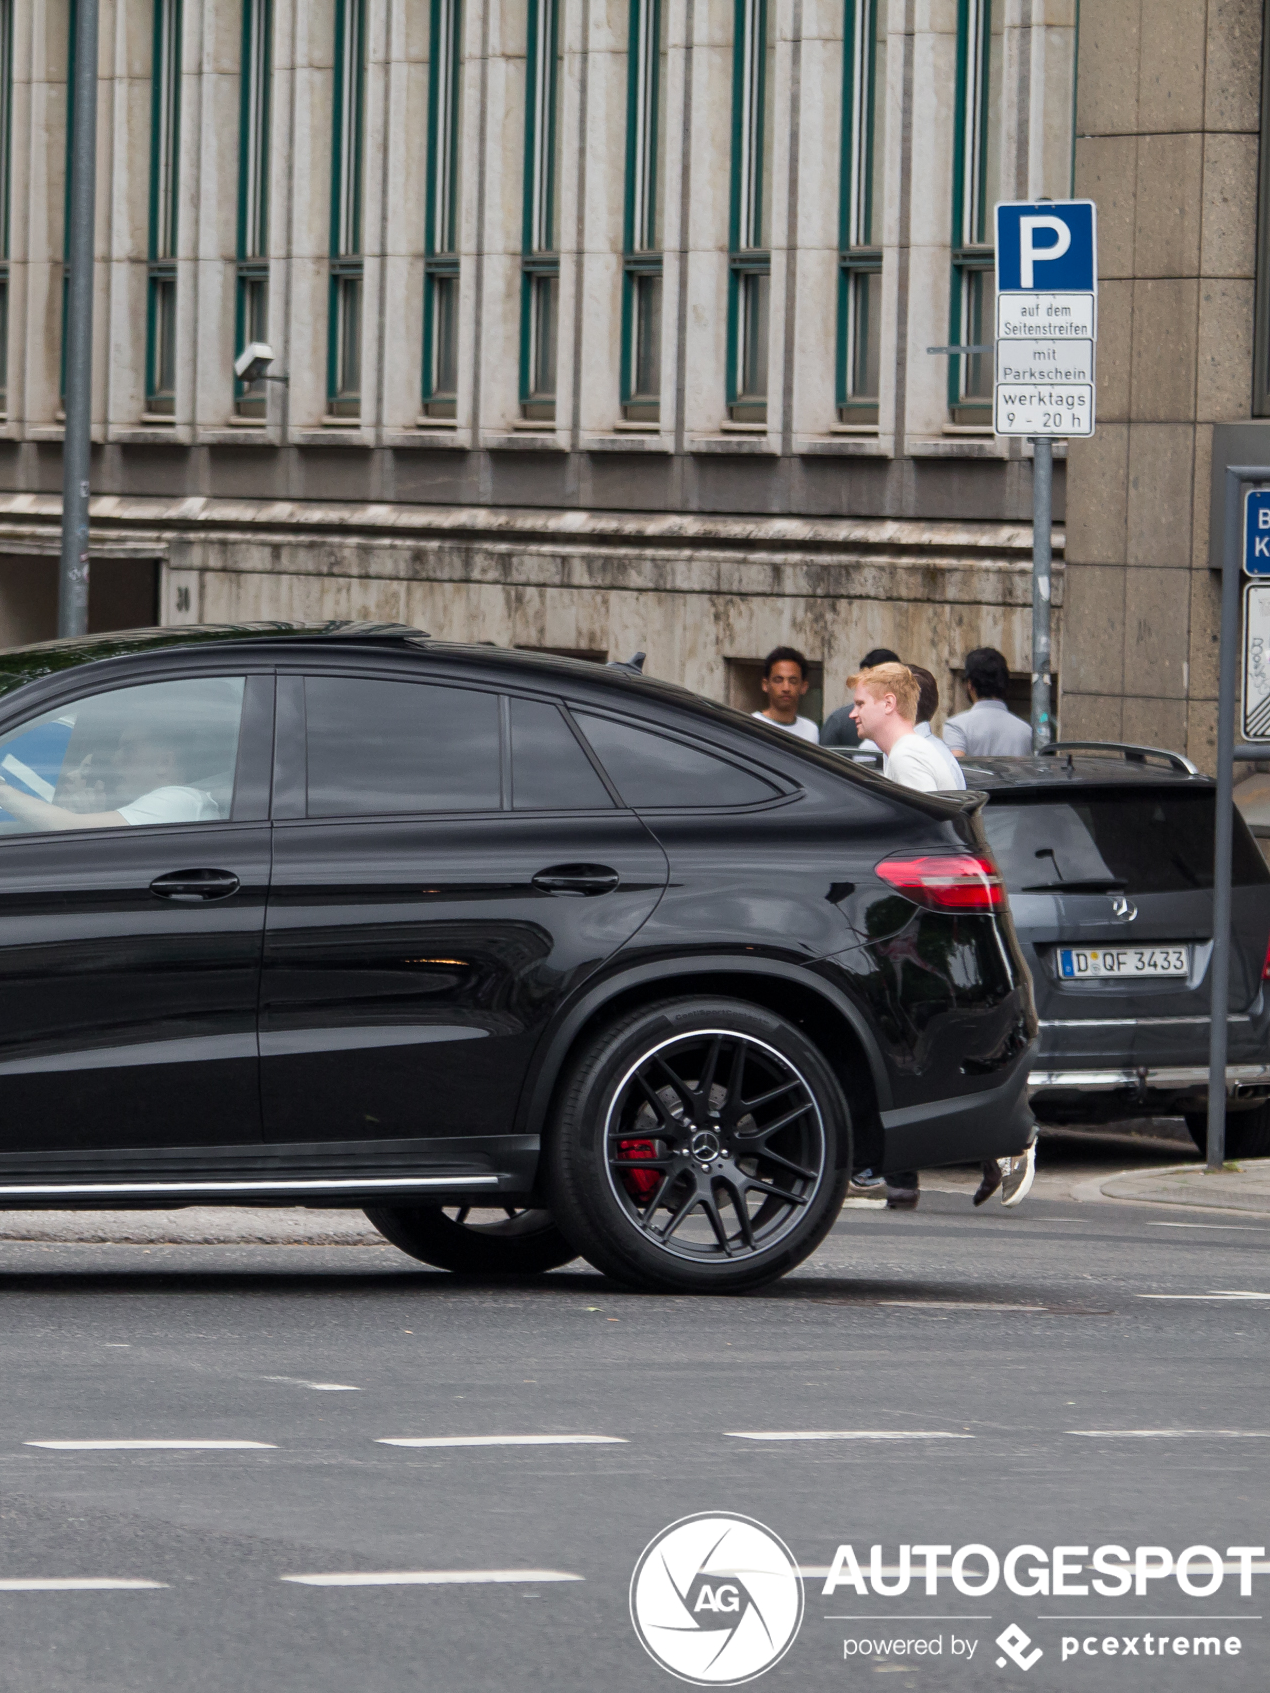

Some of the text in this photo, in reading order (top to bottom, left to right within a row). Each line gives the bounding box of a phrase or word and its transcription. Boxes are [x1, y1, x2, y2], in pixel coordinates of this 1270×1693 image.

[1019, 214, 1071, 289] P
[1021, 303, 1072, 317] auf dem
[1004, 322, 1088, 336] Seitenstreifen
[1032, 348, 1057, 361] mit
[1003, 367, 1087, 381] Parkschein
[1003, 391, 1086, 410] werktags
[1006, 412, 1016, 428] 9
[1042, 412, 1063, 428] 20
[1072, 412, 1082, 428] h
[1075, 951, 1184, 973] D QF 3433
